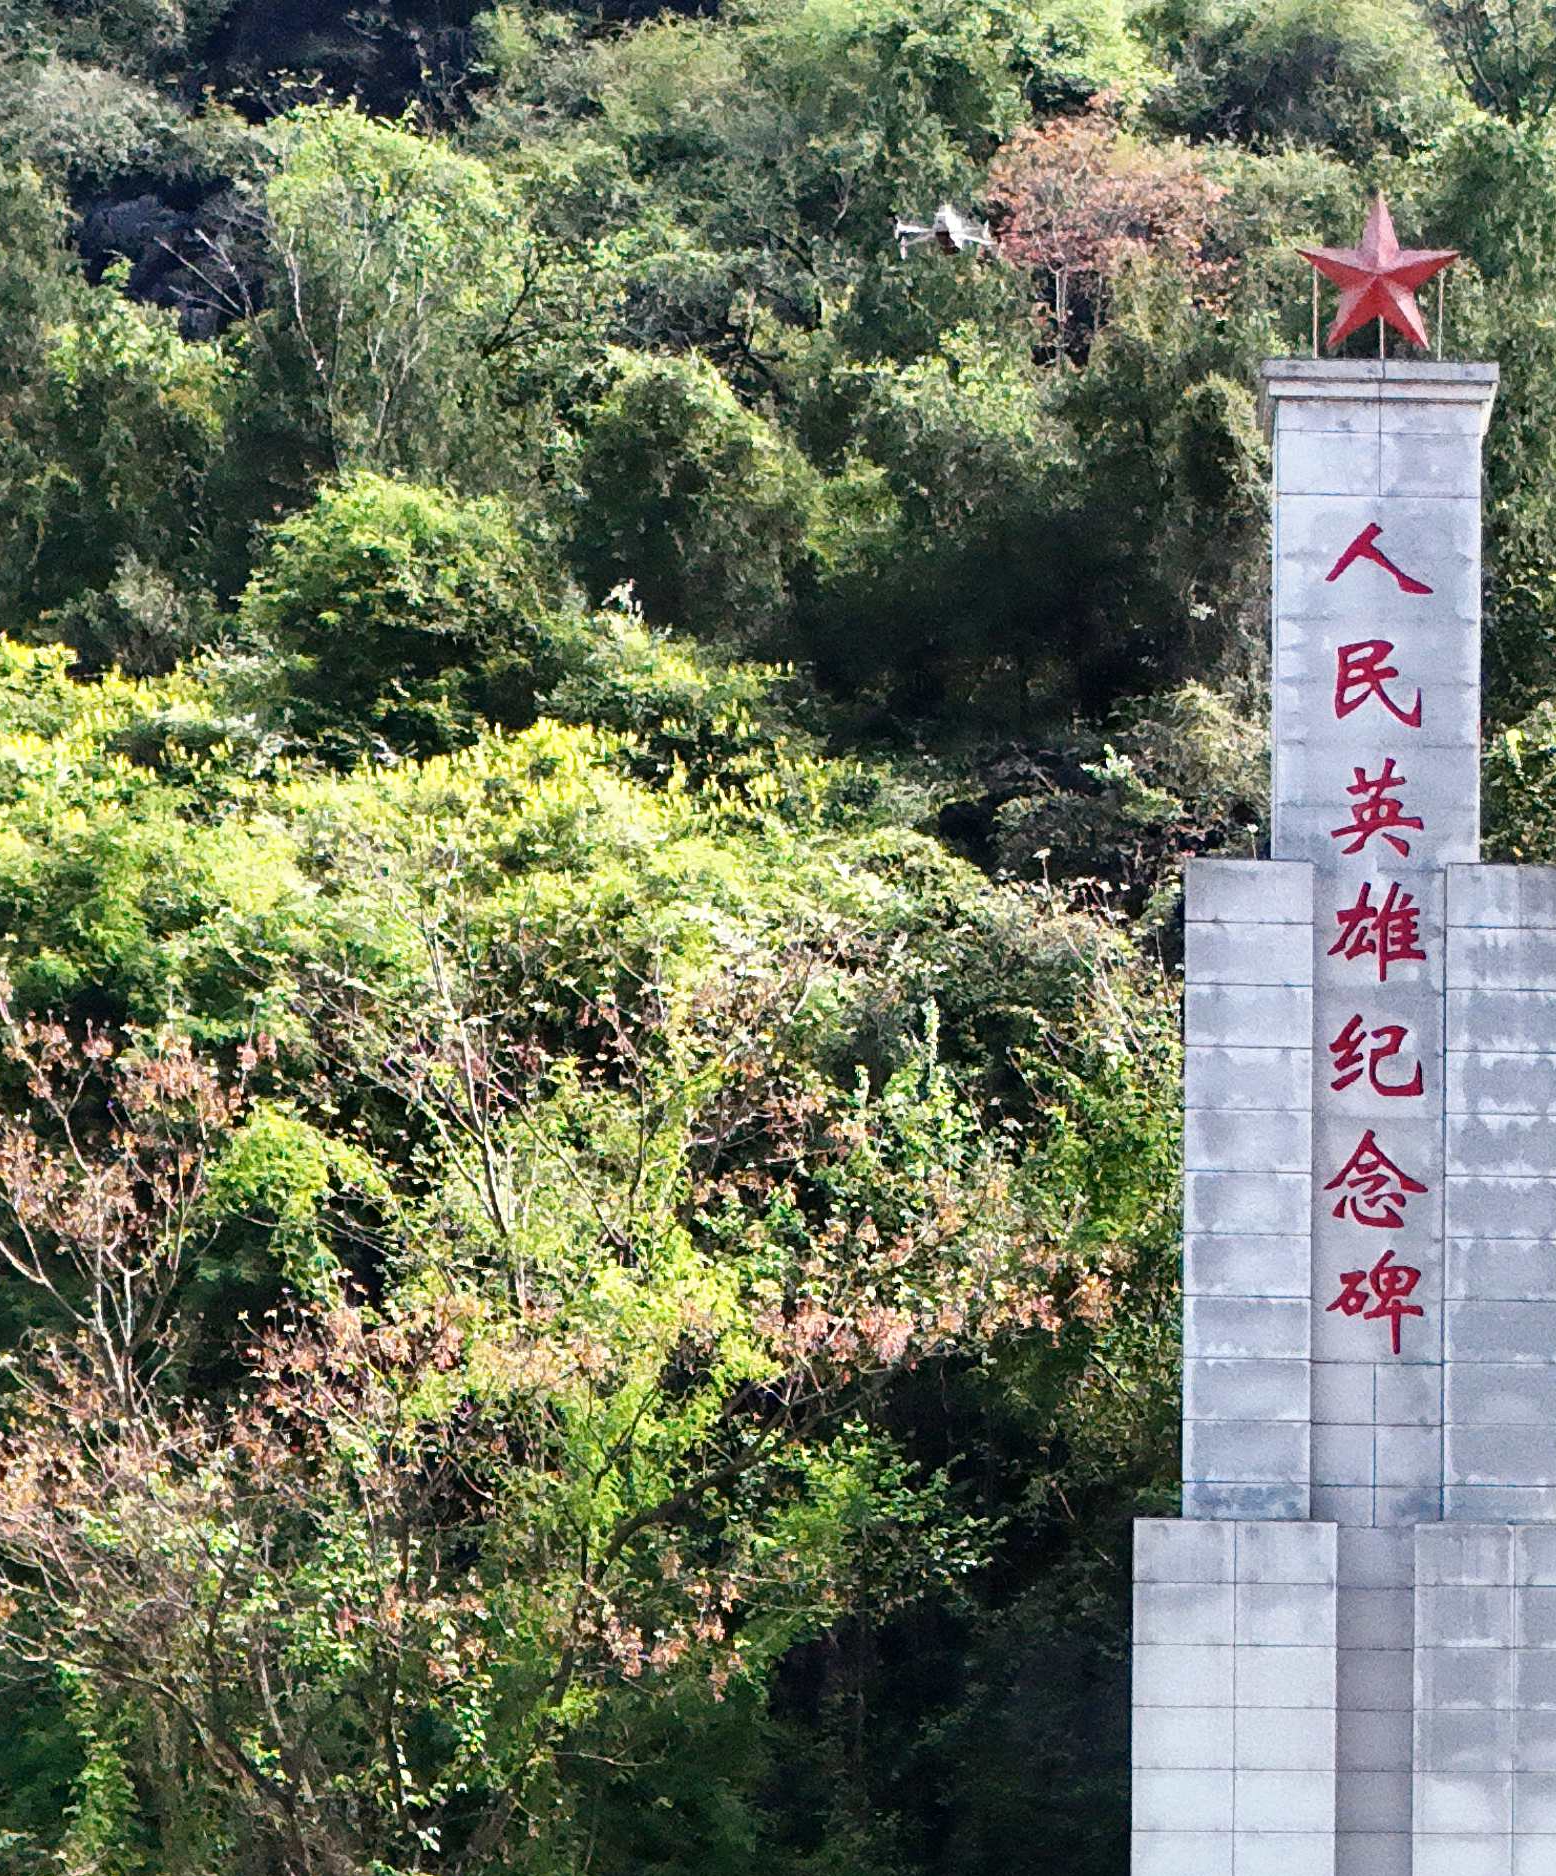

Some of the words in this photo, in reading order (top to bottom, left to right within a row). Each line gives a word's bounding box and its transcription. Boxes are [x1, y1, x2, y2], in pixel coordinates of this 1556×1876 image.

[1325, 522, 1432, 1354] 人民英雄纪念碑
